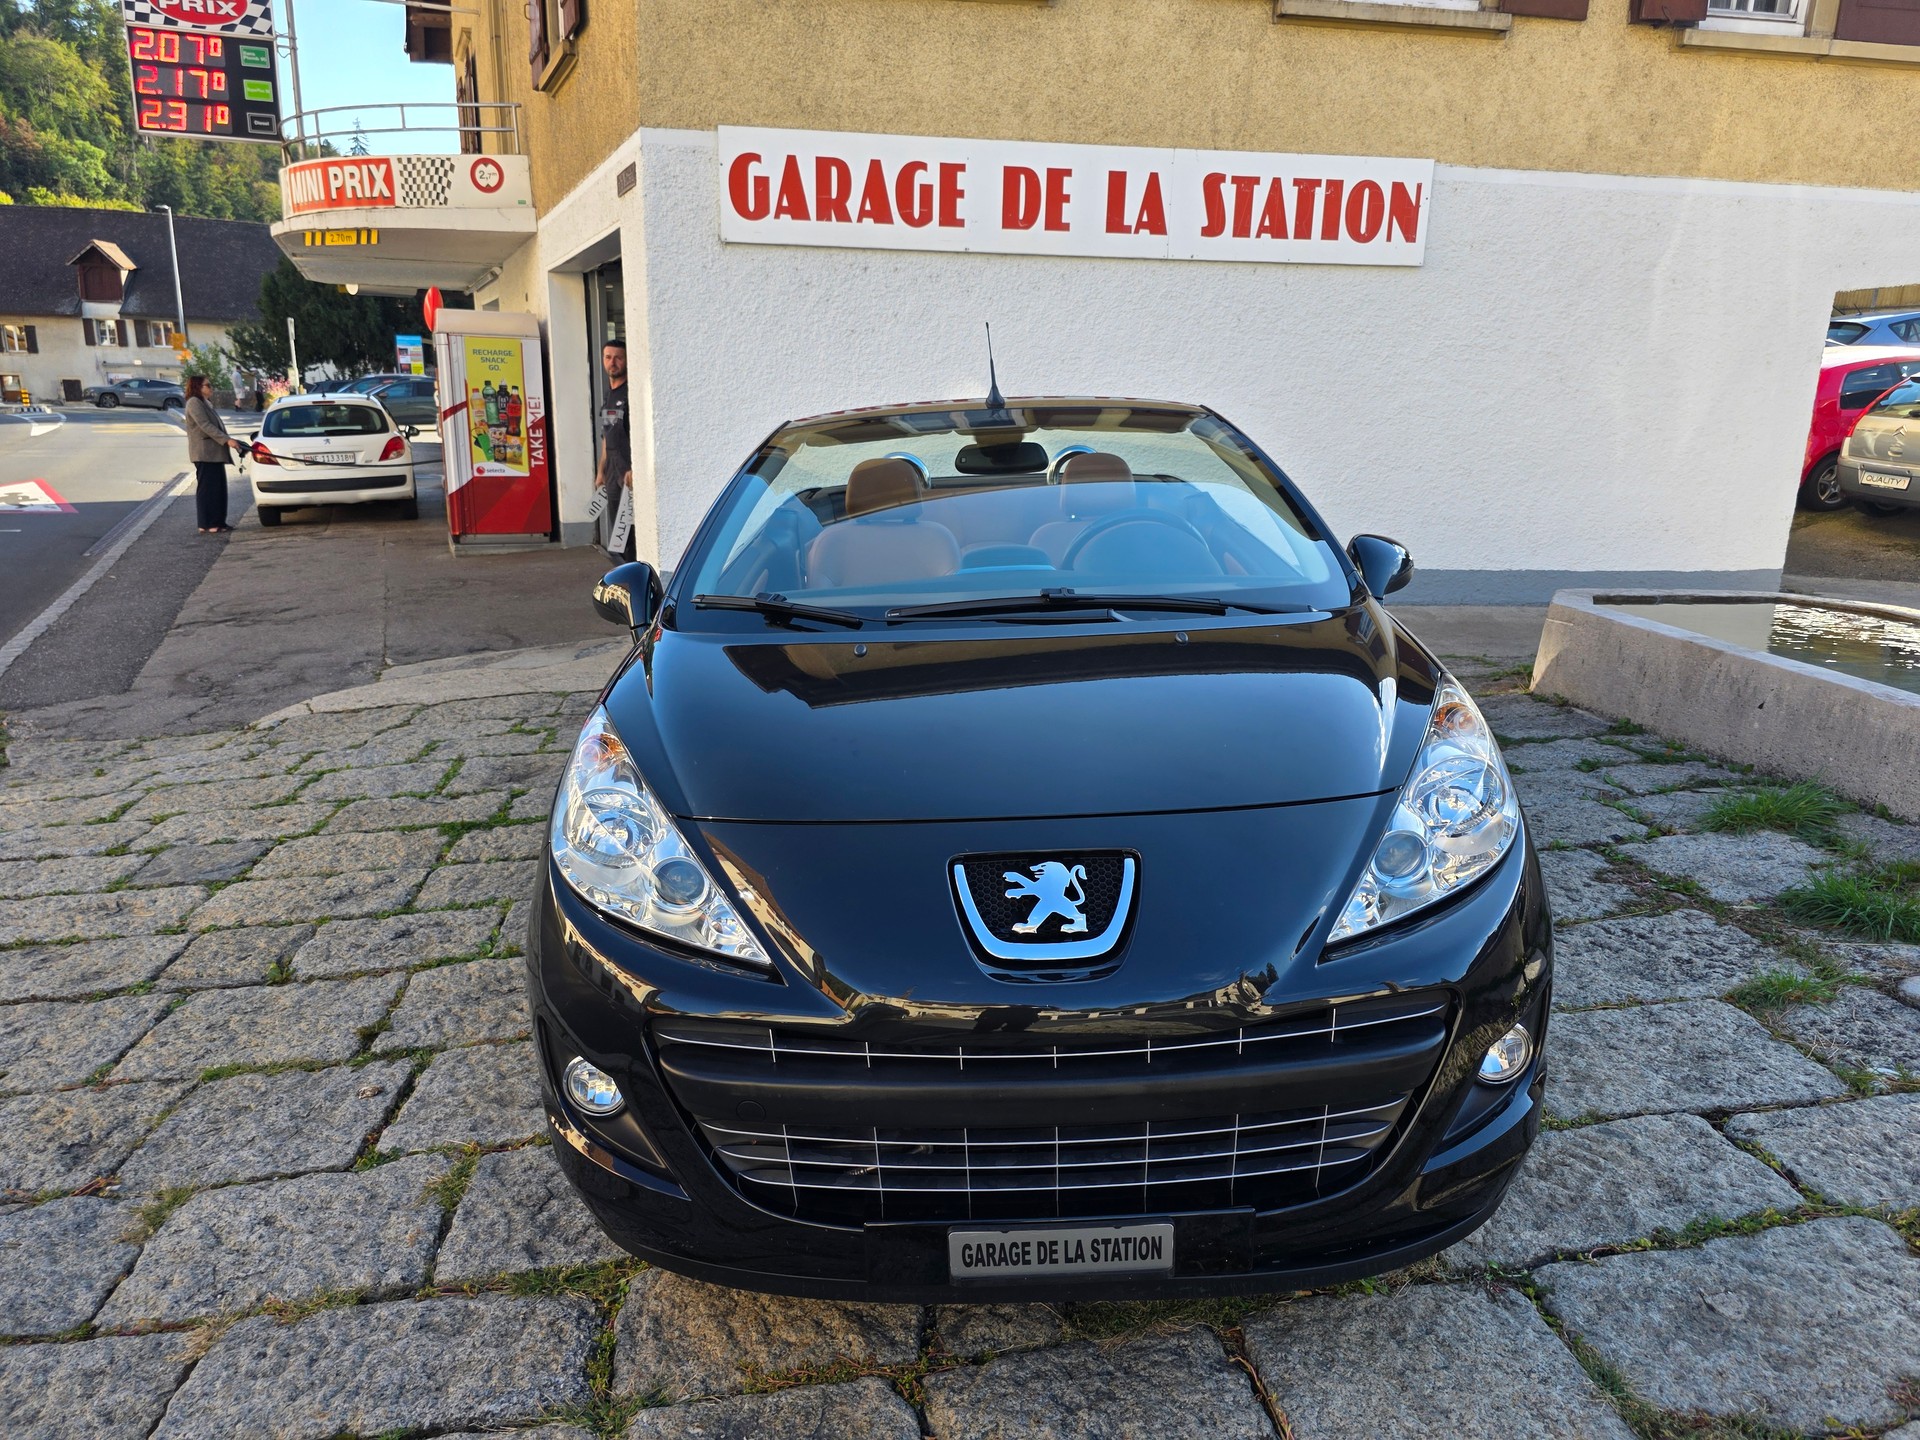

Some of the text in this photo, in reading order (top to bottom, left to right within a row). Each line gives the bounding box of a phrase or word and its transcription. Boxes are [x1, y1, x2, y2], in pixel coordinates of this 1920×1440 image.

[158, 0, 239, 17] PRIX
[291, 164, 391, 205] MINI PRIX
[728, 152, 1422, 244] GARAGE DE LA STATION
[528, 397, 544, 468] TAKE ME!
[1866, 475, 1901, 485] QUALITY
[961, 1236, 1163, 1268] GARAGE DE LA STATION
